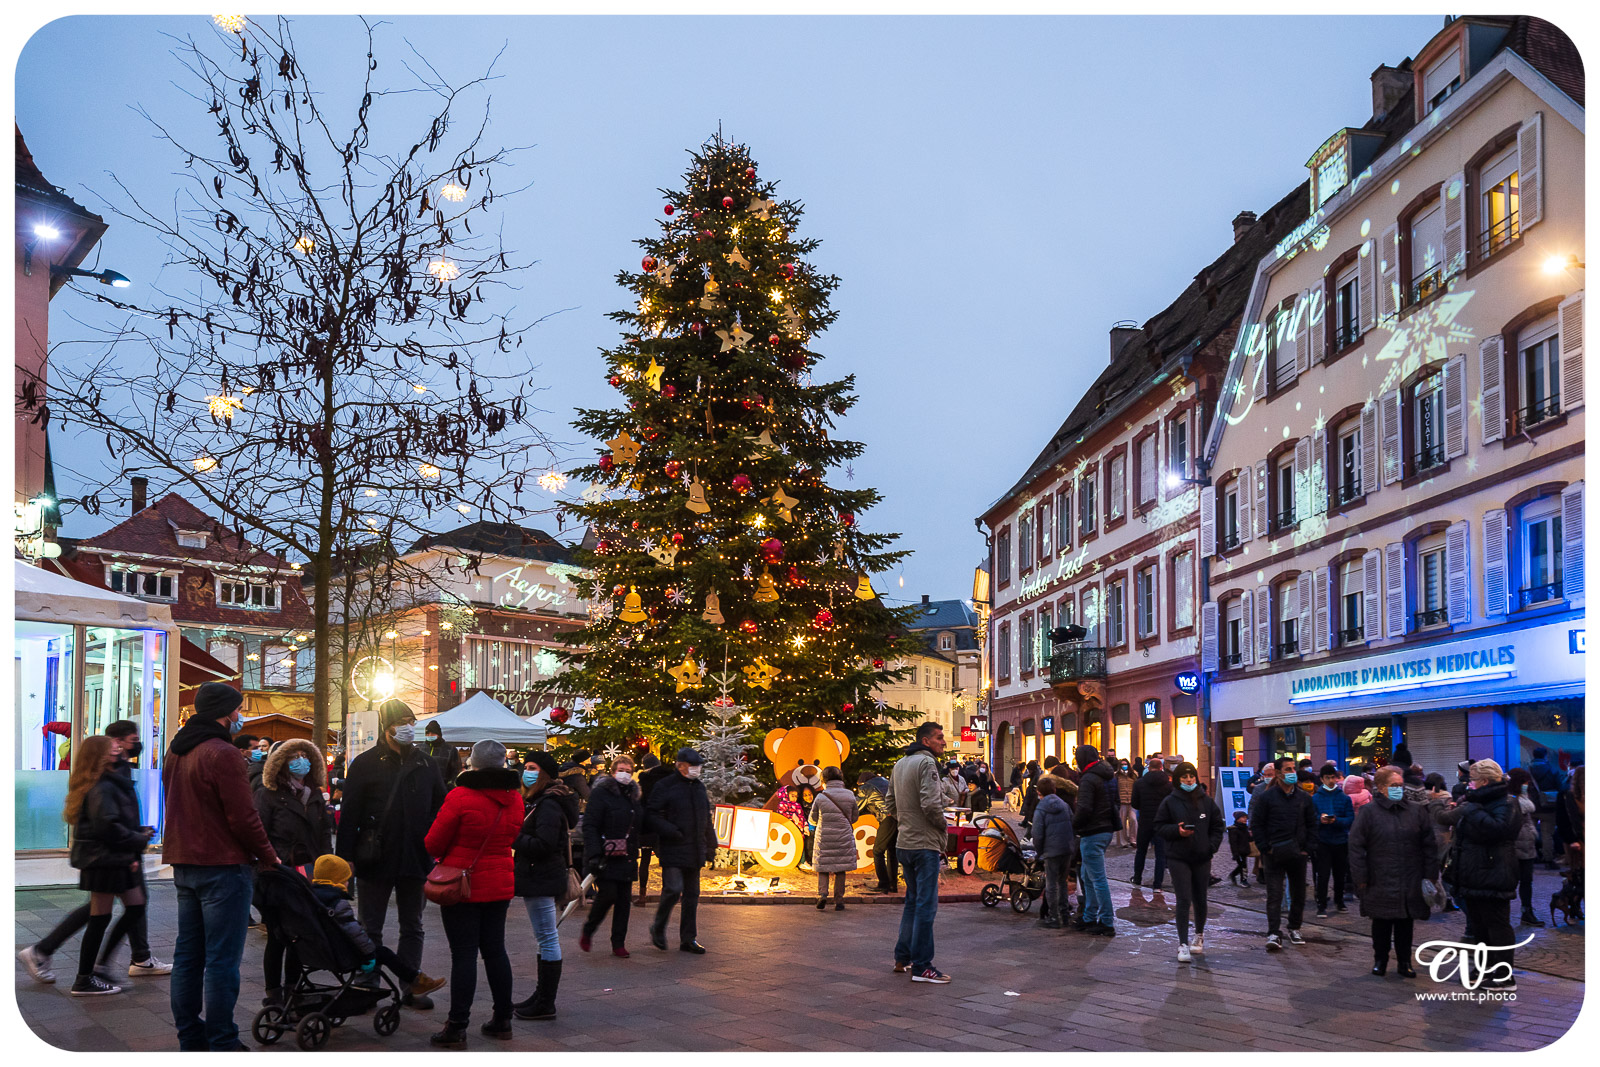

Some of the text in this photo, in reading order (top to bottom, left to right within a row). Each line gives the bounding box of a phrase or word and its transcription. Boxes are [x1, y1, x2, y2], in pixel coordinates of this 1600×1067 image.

[1053, 540, 1090, 586] Fest
[493, 566, 567, 609] Auguri
[1292, 645, 1515, 694] LABORATOIRE D'ANALYSES MEDICALES
[513, 681, 575, 716] Wihes
